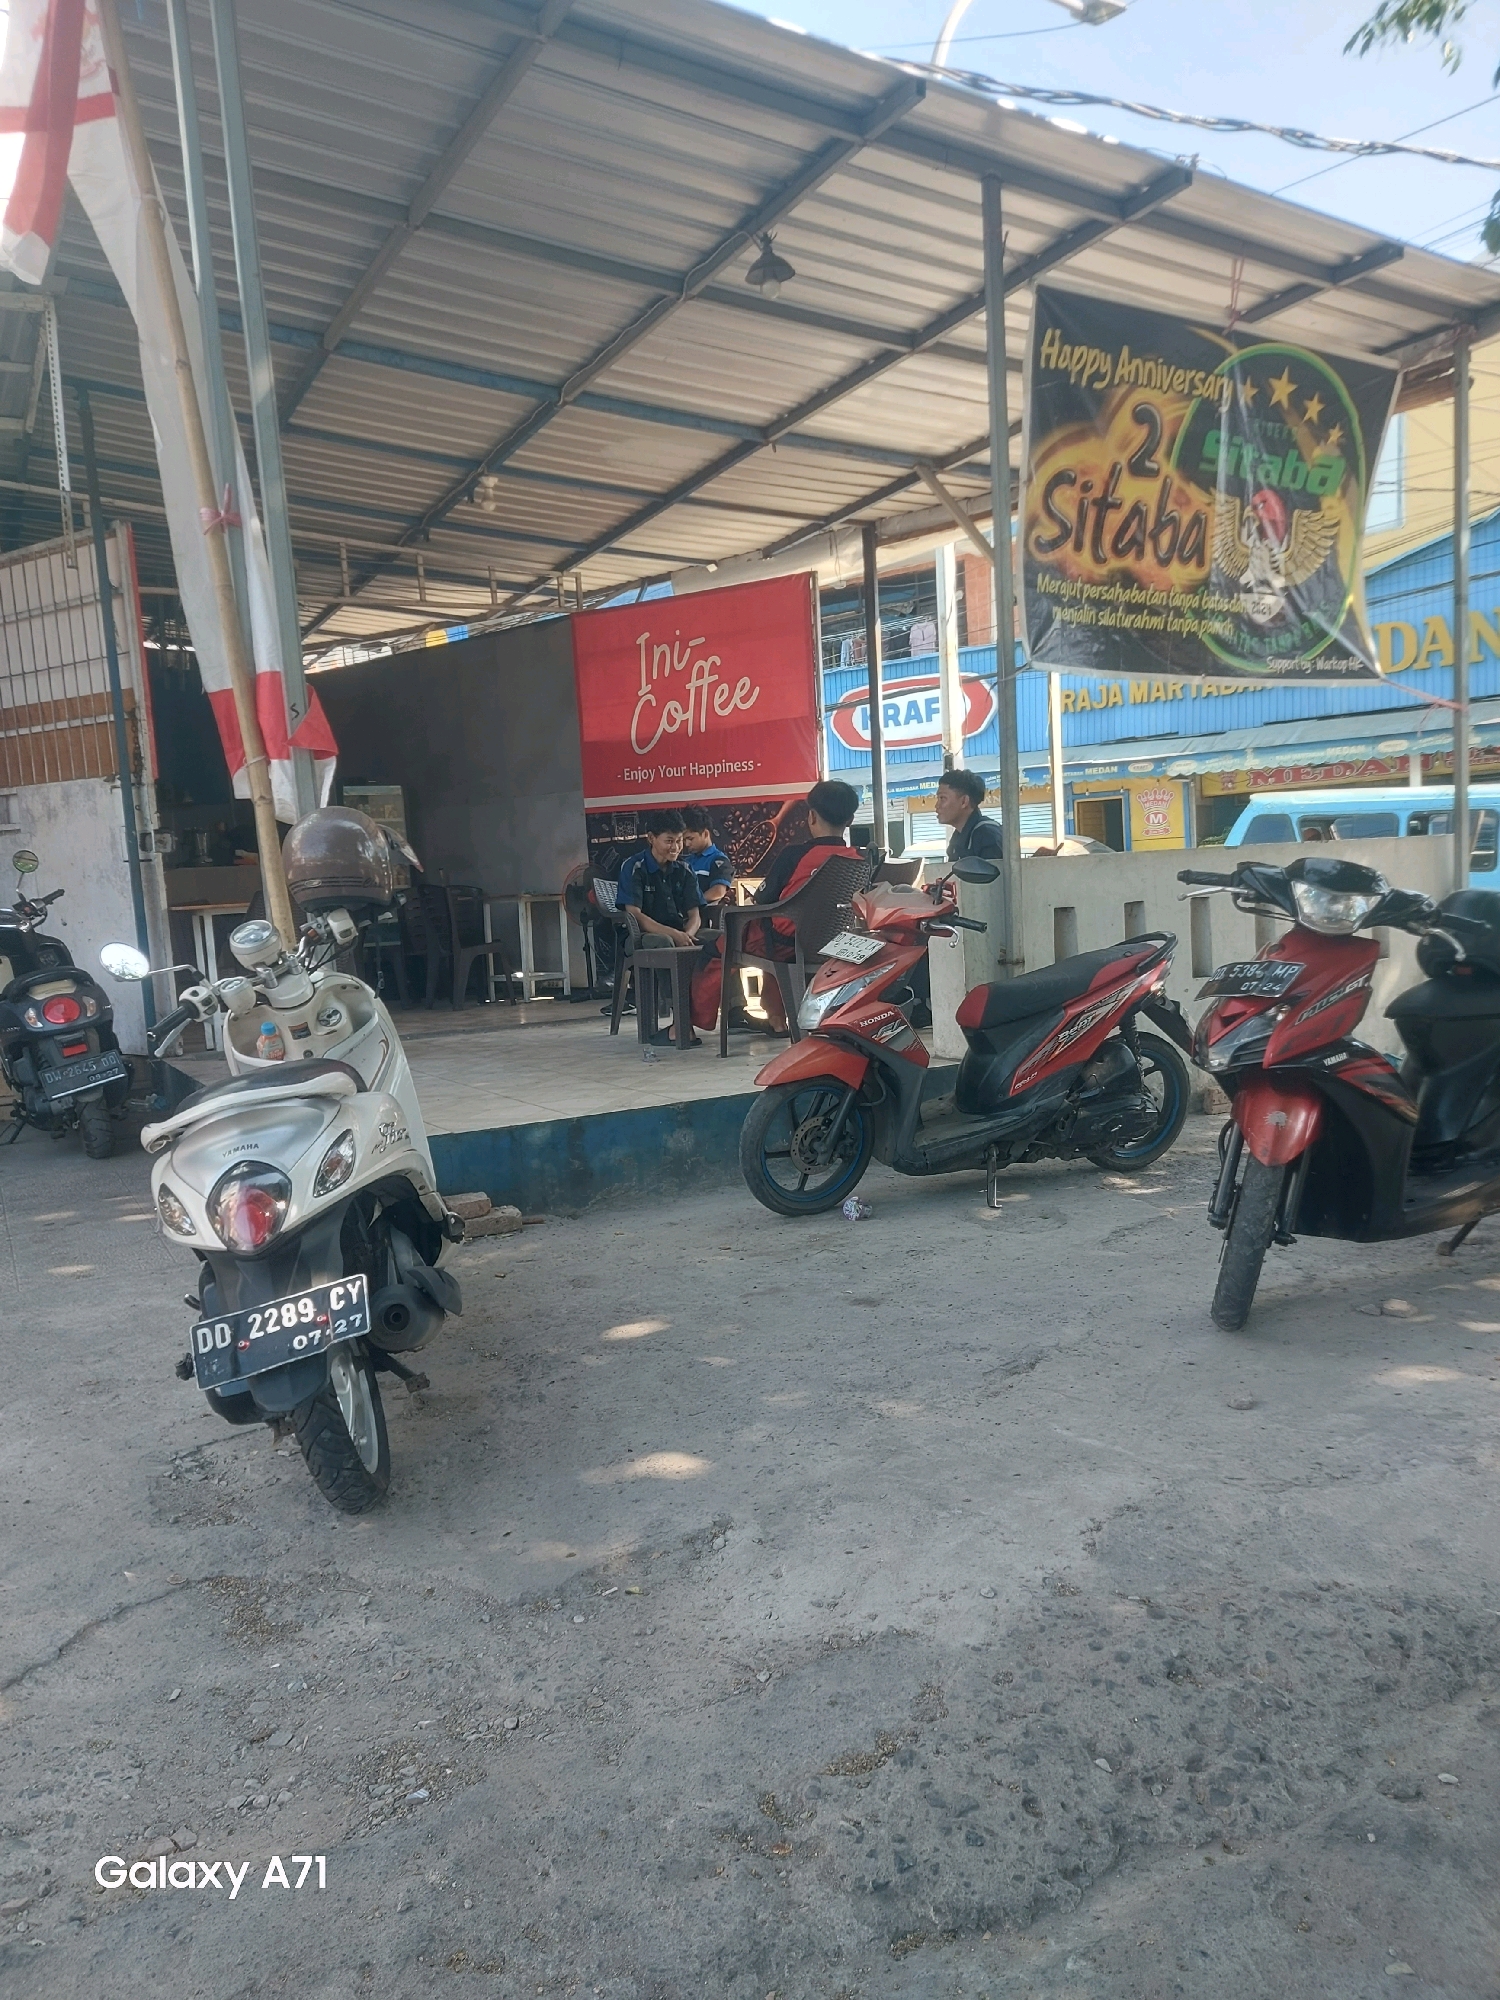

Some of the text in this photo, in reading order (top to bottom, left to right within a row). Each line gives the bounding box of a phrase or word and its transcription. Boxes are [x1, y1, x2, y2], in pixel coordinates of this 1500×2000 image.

[1040, 327, 1233, 412] Happy Anniversary
[1128, 402, 1162, 477] 2
[1199, 428, 1347, 495] Sitaba
[1034, 461, 1207, 568] Sitaba
[1036, 572, 1082, 602] Merajut
[1082, 582, 1167, 606] persahabatan
[1169, 585, 1200, 613] tanpa
[1052, 604, 1096, 628] menjalin
[1097, 607, 1166, 630] silaturahmi
[1266, 656, 1301, 674] Support
[1316, 656, 1347, 674] Warkop
[630, 655, 760, 755] Coffee
[1060, 683, 1124, 714] RAJA
[861, 696, 940, 731] KRAF
[623, 759, 754, 783] Enjoy Your Happiness
[1085, 765, 1118, 775] MEDAN
[1249, 752, 1434, 788] MEDAN
[1144, 799, 1169, 808] MEDAN
[1149, 813, 1164, 824] M
[1272, 964, 1299, 979] MP
[859, 1010, 895, 1028] HONDA
[45, 1070, 62, 1084] DW
[67, 1061, 97, 1078] 2645
[1322, 1052, 1349, 1067] YAMAHA
[221, 1142, 260, 1158] YAMAHA
[197, 1280, 362, 1354] DD 2289 CY
